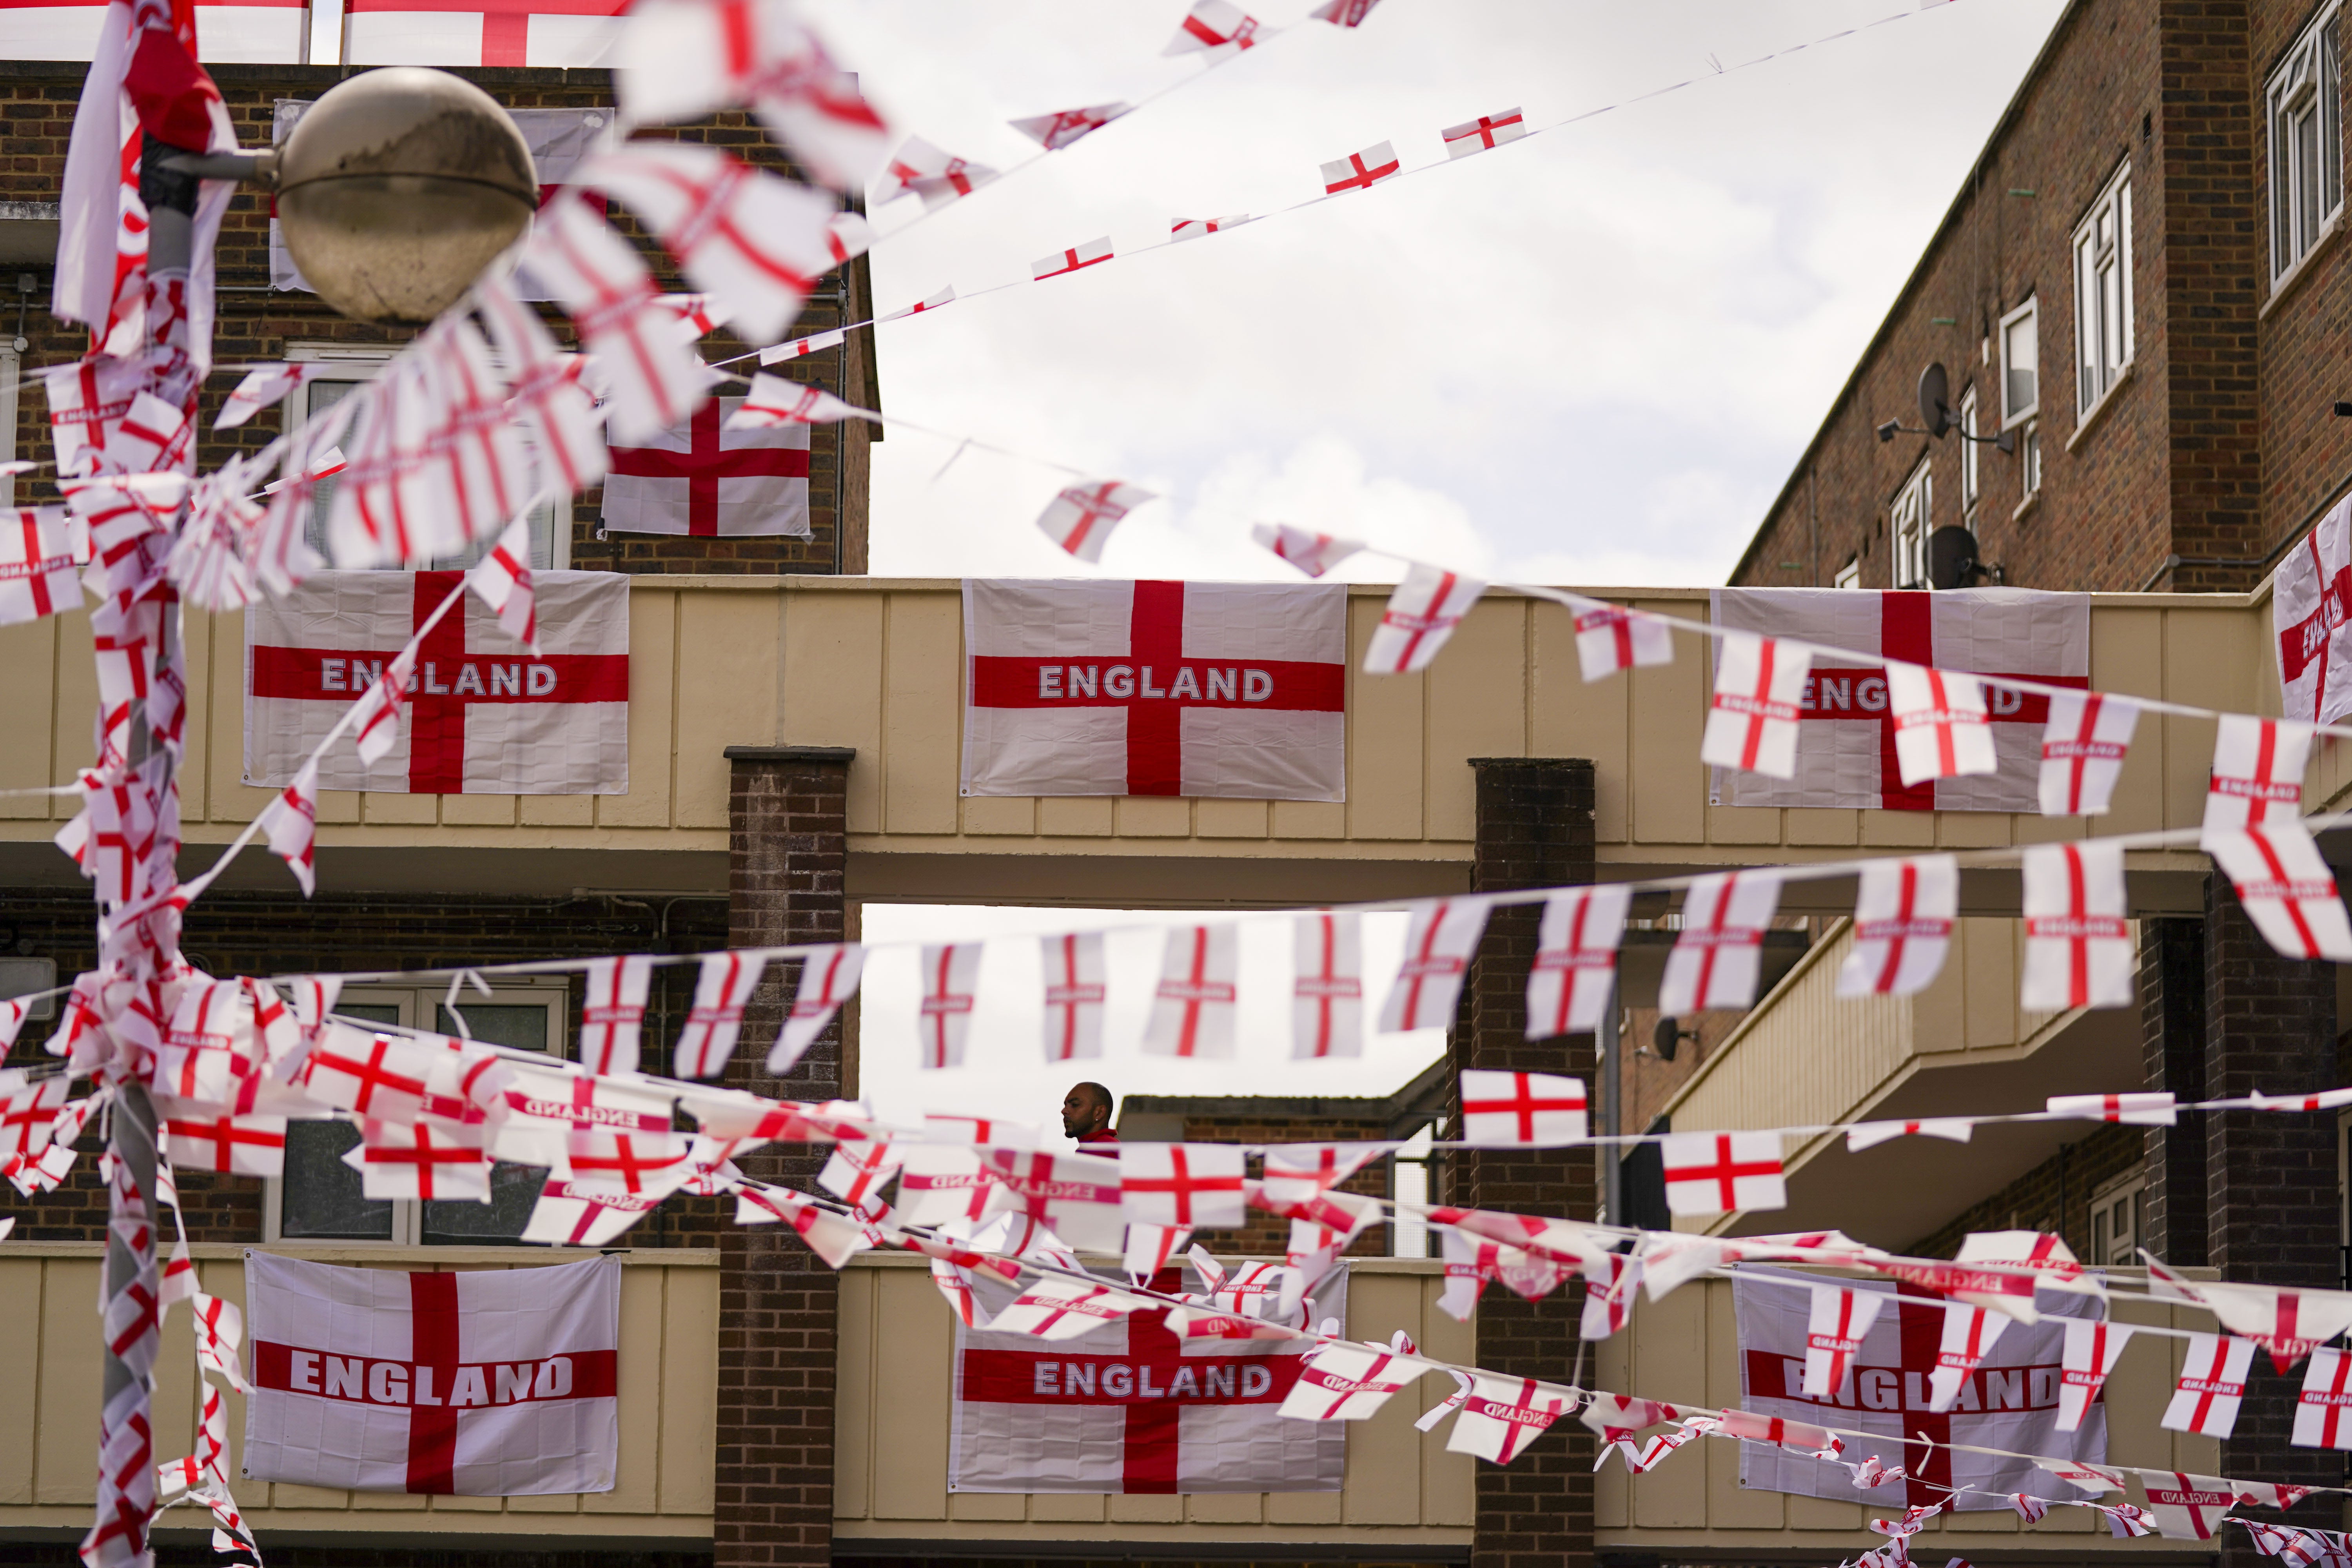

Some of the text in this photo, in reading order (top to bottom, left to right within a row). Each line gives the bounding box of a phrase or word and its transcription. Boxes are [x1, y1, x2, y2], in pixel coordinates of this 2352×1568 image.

[1039, 664, 1274, 702] ENGLAND
[1800, 677, 2023, 714] ENGD
[2219, 779, 2298, 800] ENGLAND
[291, 1350, 573, 1406] ENGLAND
[1034, 1361, 1272, 1397] ENGLAND
